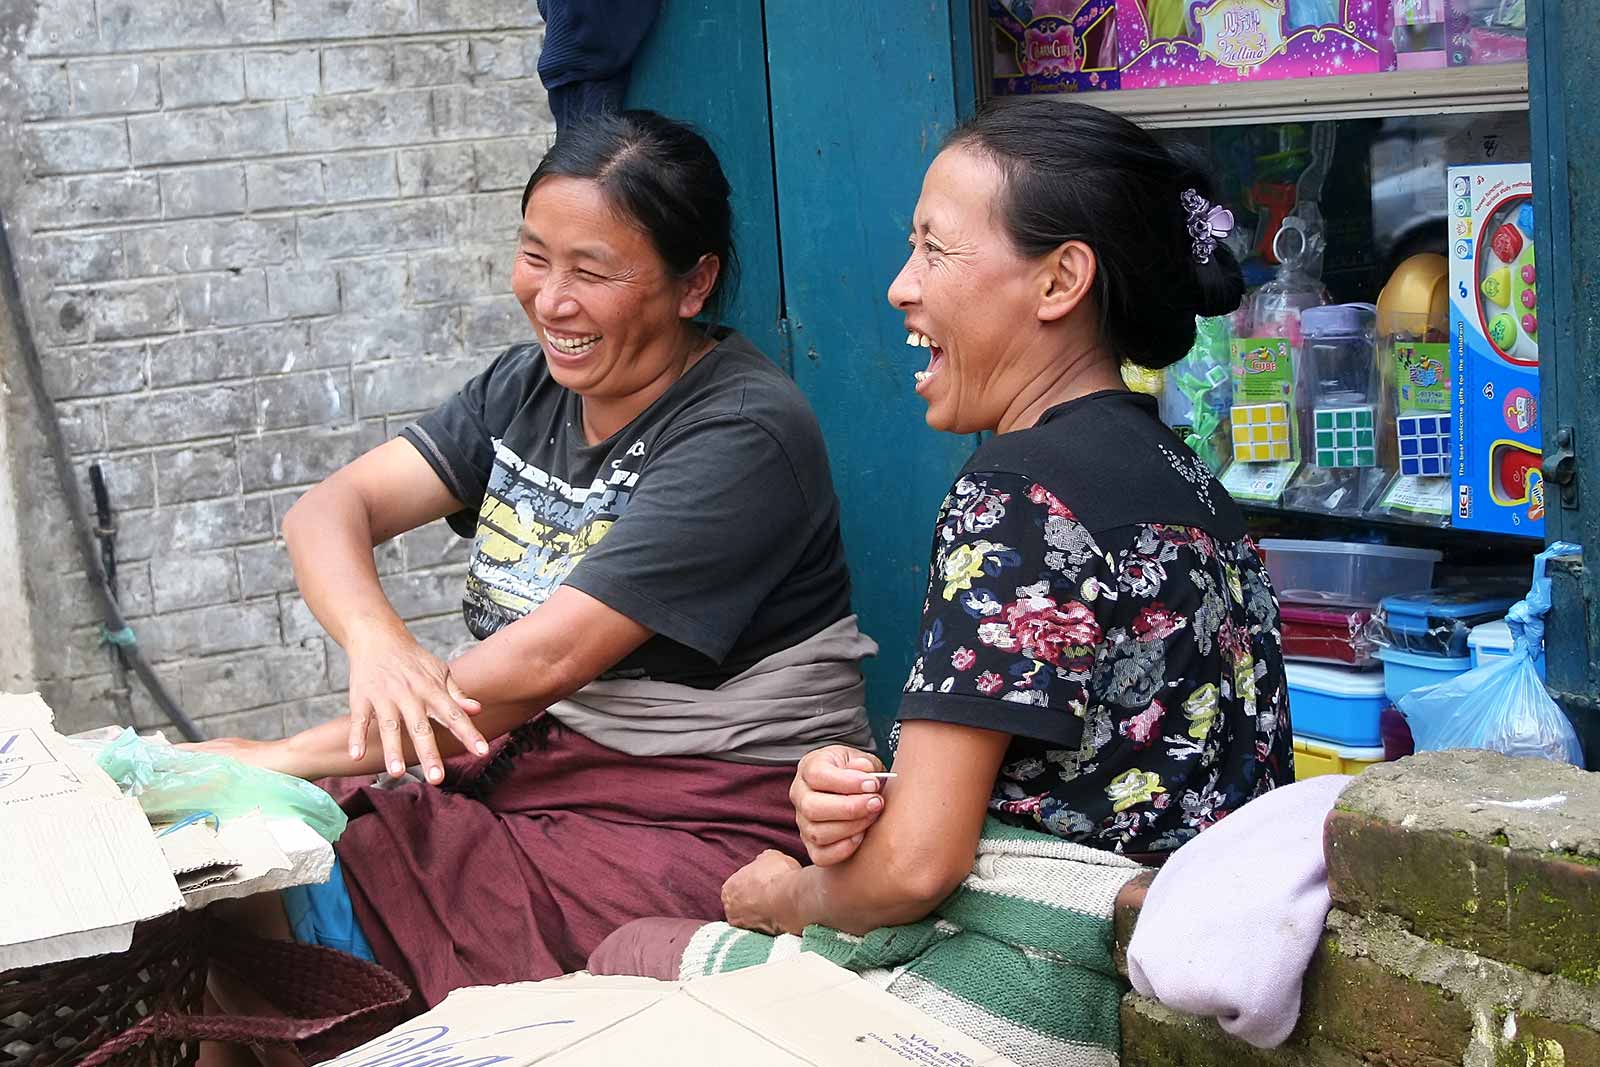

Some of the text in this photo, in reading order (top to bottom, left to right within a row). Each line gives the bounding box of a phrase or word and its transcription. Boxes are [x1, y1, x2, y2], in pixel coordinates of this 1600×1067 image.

[1458, 387, 1466, 405] gifts
[867, 1032, 914, 1061] DIMAPUR
[893, 1032, 917, 1047] NEW
[911, 1033, 939, 1053] VIVA
